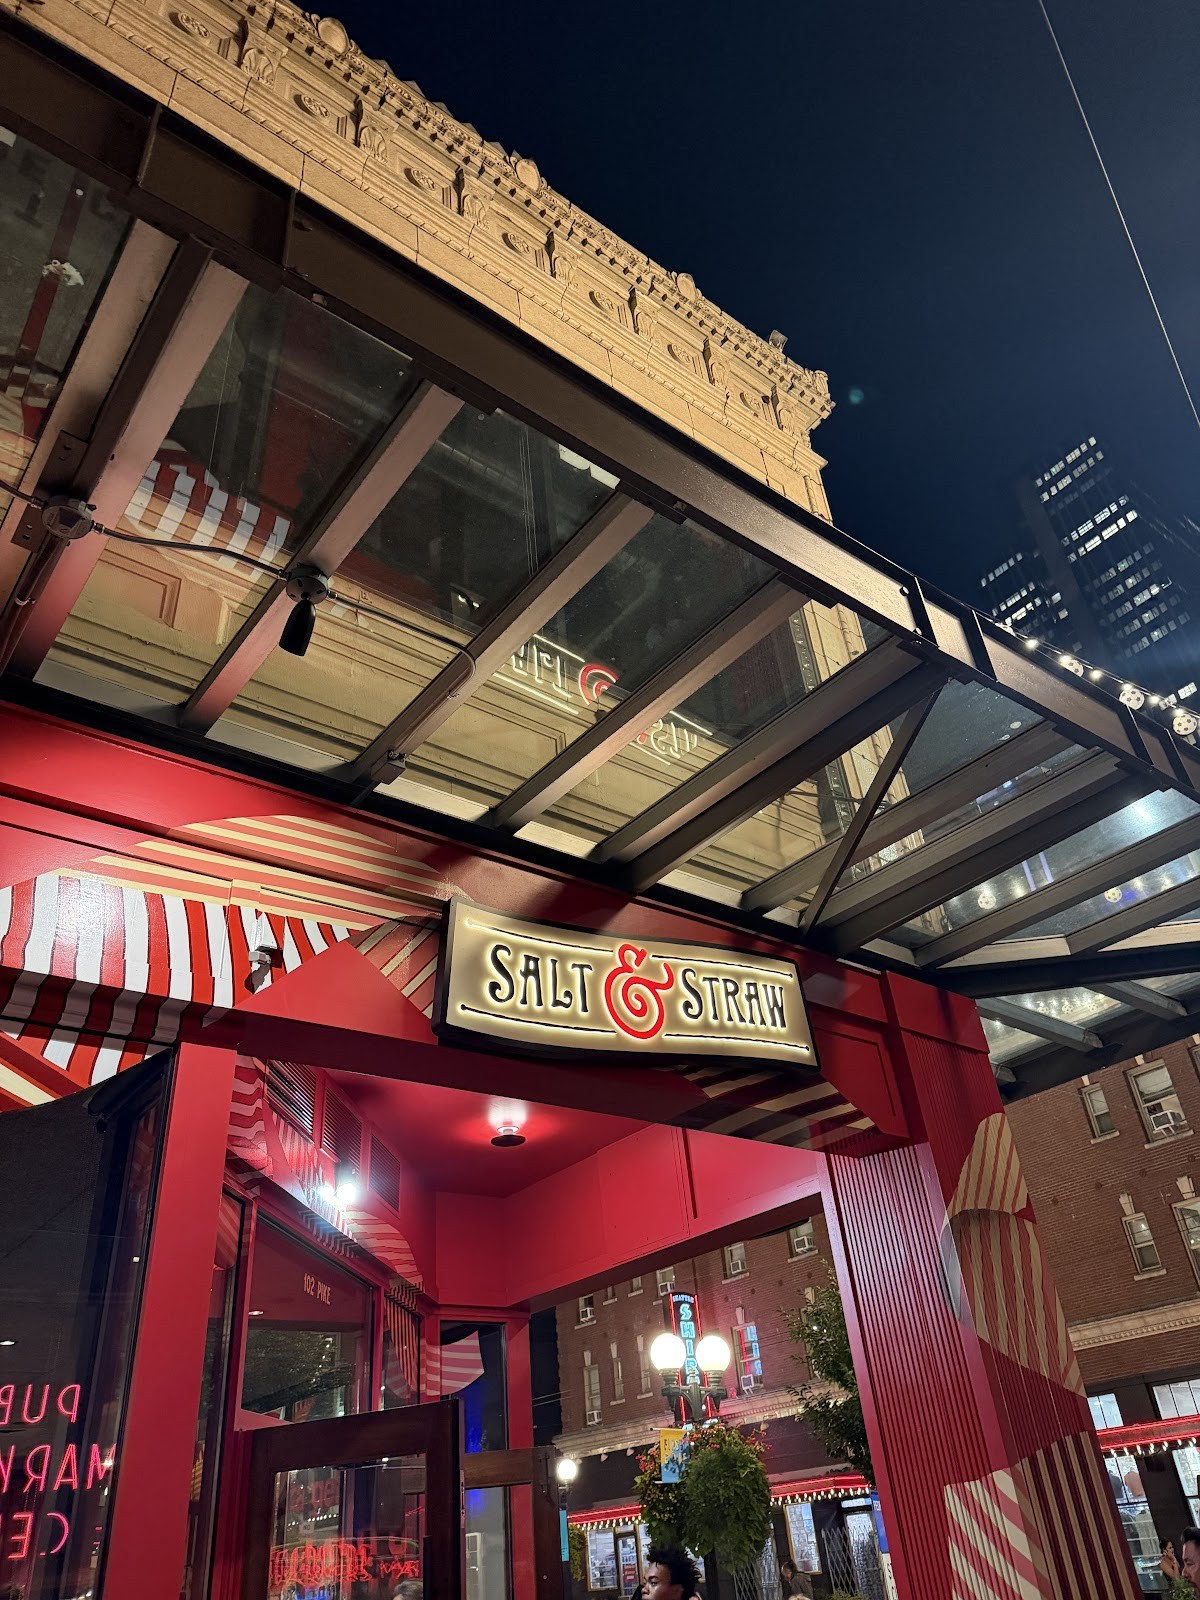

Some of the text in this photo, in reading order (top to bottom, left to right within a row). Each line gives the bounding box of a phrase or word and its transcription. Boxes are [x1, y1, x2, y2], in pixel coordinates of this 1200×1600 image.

[488, 943, 787, 1040] SALT & STRAW
[303, 1272, 331, 1305] 102 PIKE
